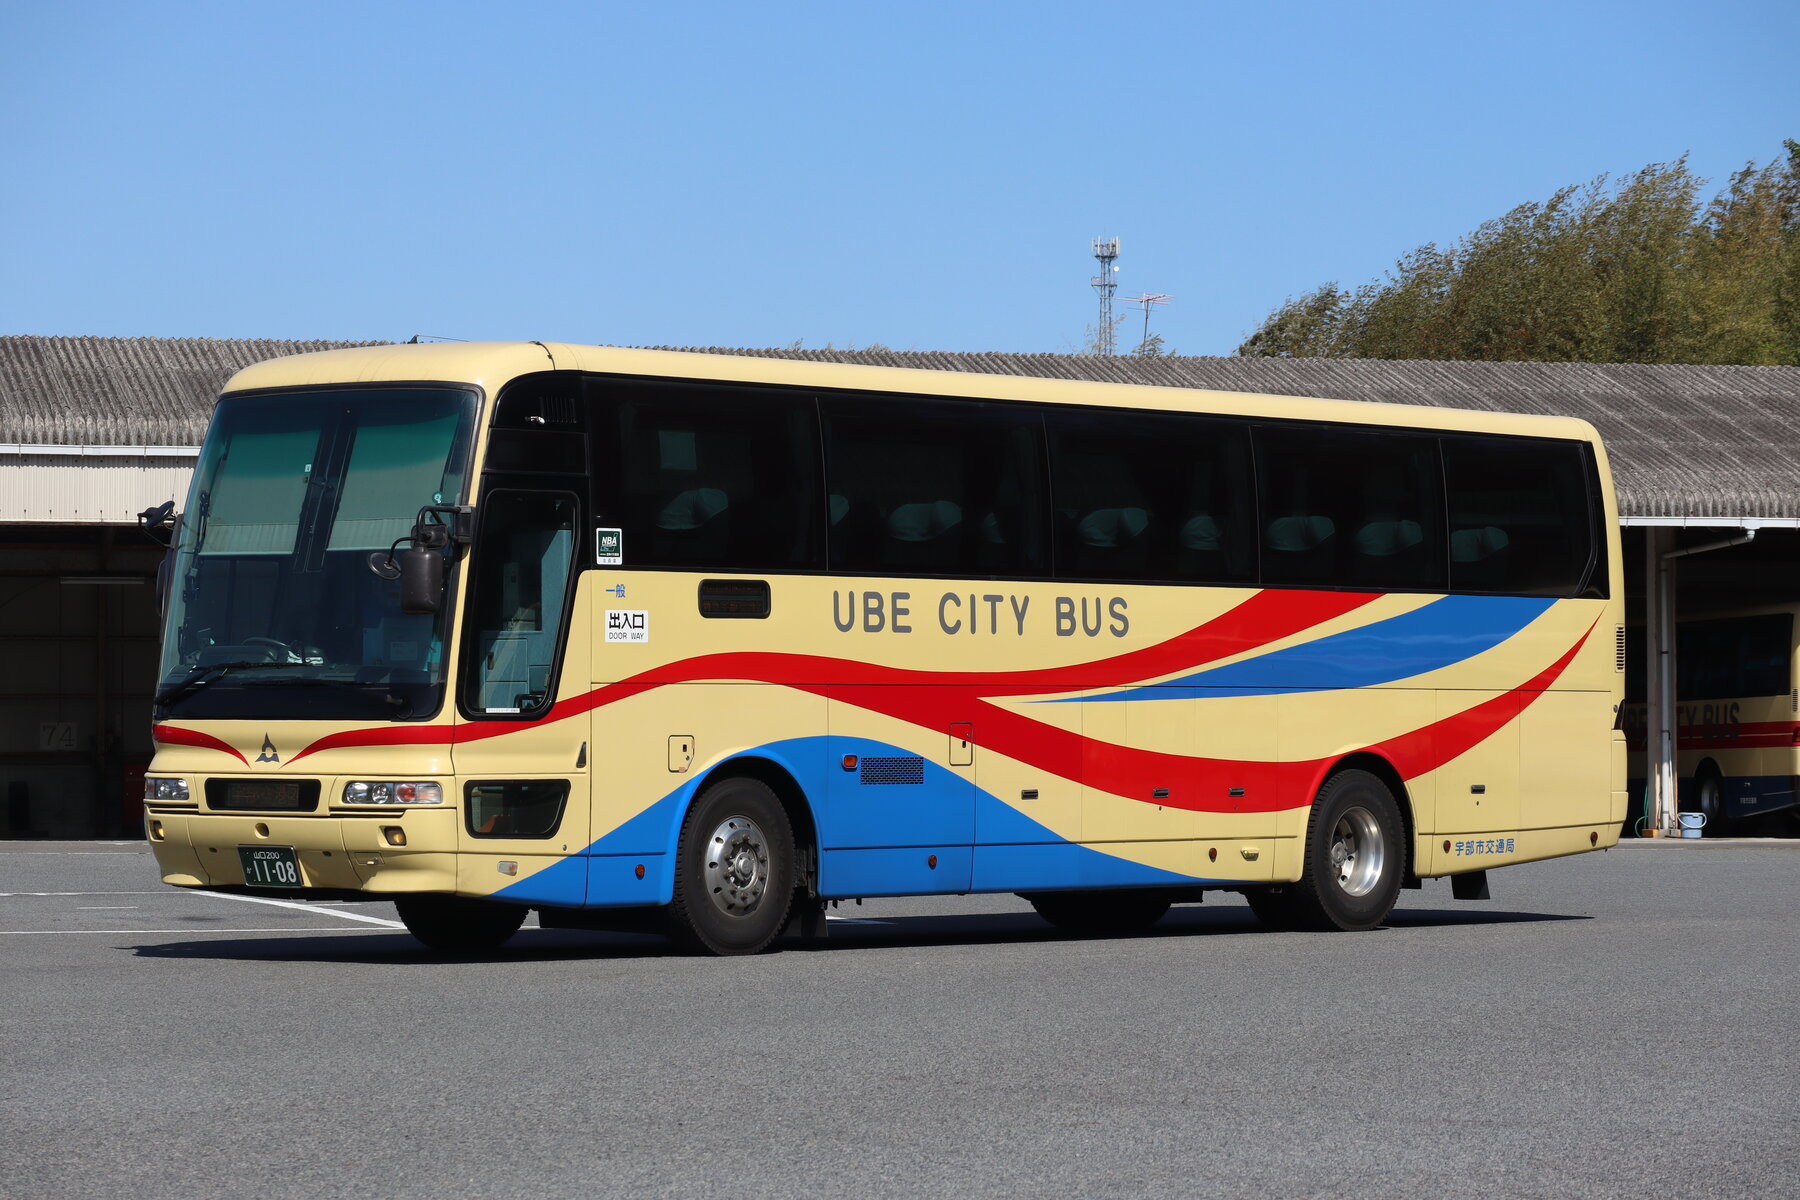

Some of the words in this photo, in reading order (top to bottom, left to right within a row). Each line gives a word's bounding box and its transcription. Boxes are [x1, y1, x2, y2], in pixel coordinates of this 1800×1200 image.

[602, 537, 617, 545] NBA
[605, 584, 626, 598] 一般
[609, 613, 644, 629] 出入口
[833, 590, 912, 633] UBE
[938, 592, 1030, 636] CITY
[1055, 597, 1129, 638] BUS
[631, 632, 644, 640] WAY
[1703, 702, 1740, 739] BUS
[43, 726, 74, 746] 74
[1455, 838, 1514, 856] 宇部市交通局
[253, 861, 296, 882] 11-08
